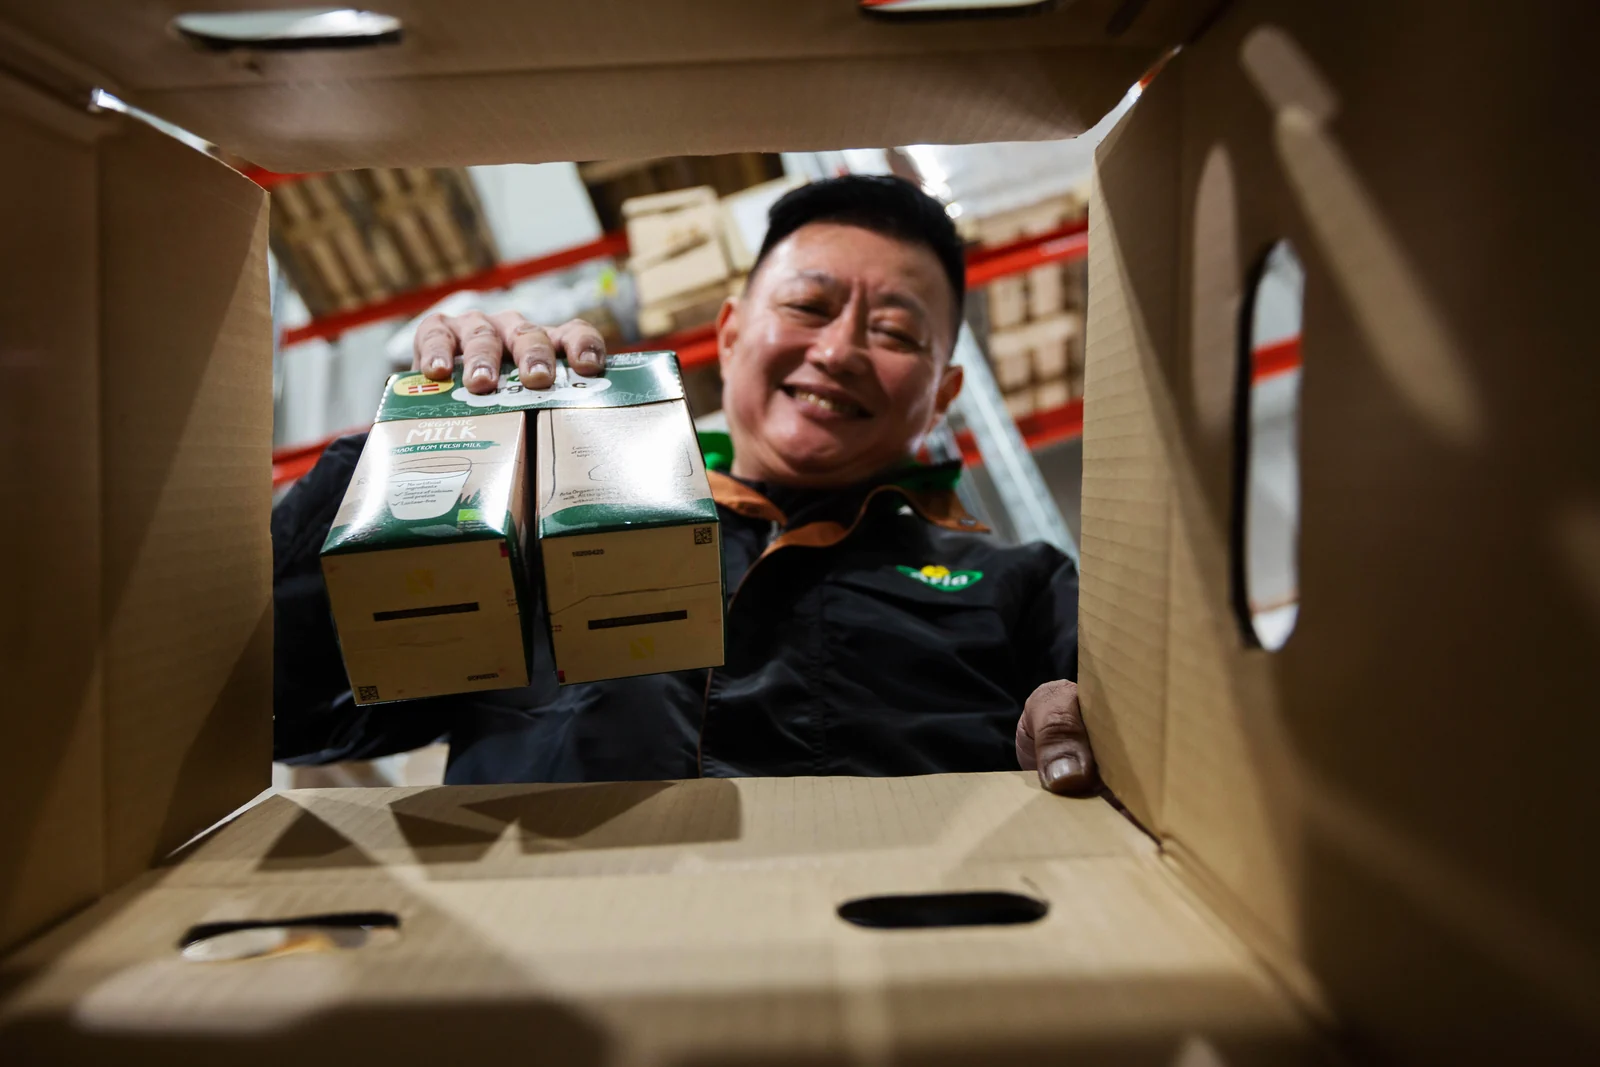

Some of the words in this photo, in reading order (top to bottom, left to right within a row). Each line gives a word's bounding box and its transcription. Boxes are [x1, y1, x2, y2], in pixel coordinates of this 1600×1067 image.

[418, 419, 473, 429] ORGANIC
[405, 426, 477, 444] MILK
[393, 447, 414, 455] MADE
